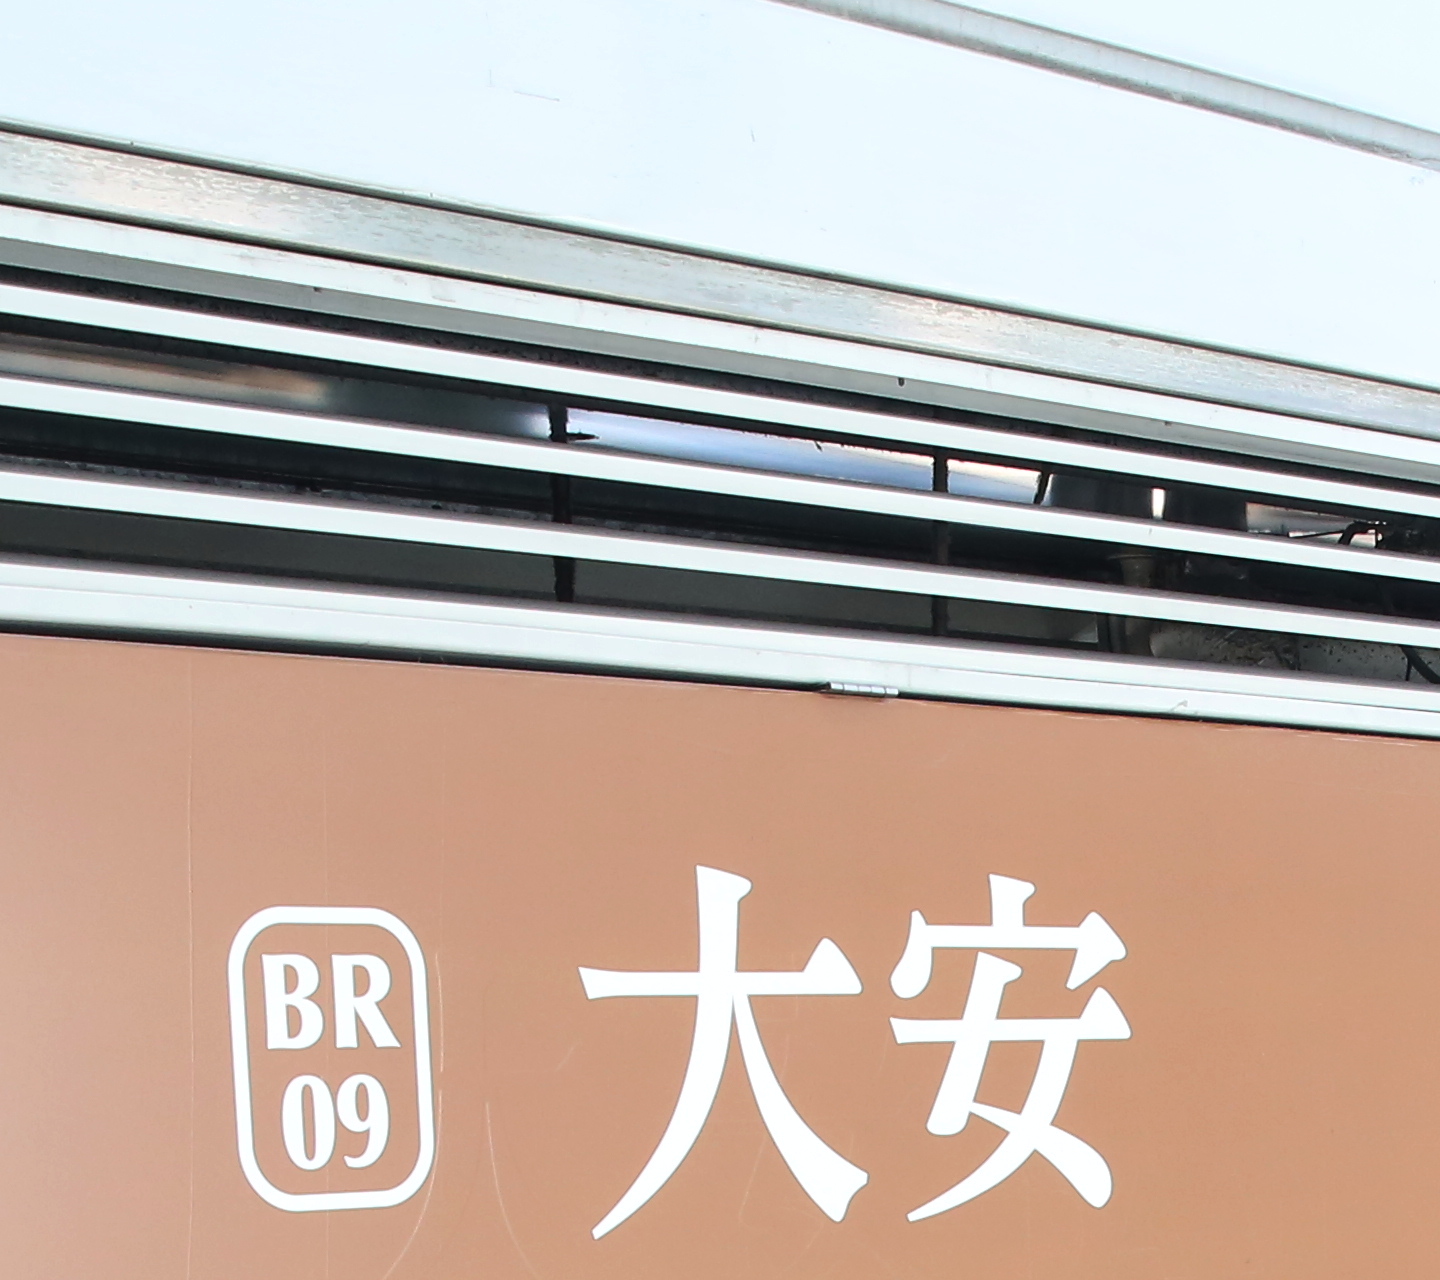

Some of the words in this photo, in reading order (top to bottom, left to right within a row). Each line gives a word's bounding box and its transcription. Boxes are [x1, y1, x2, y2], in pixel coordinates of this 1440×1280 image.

[261, 953, 400, 1051] BR
[577, 864, 1131, 1240] 大安
[280, 1073, 390, 1171] 09
